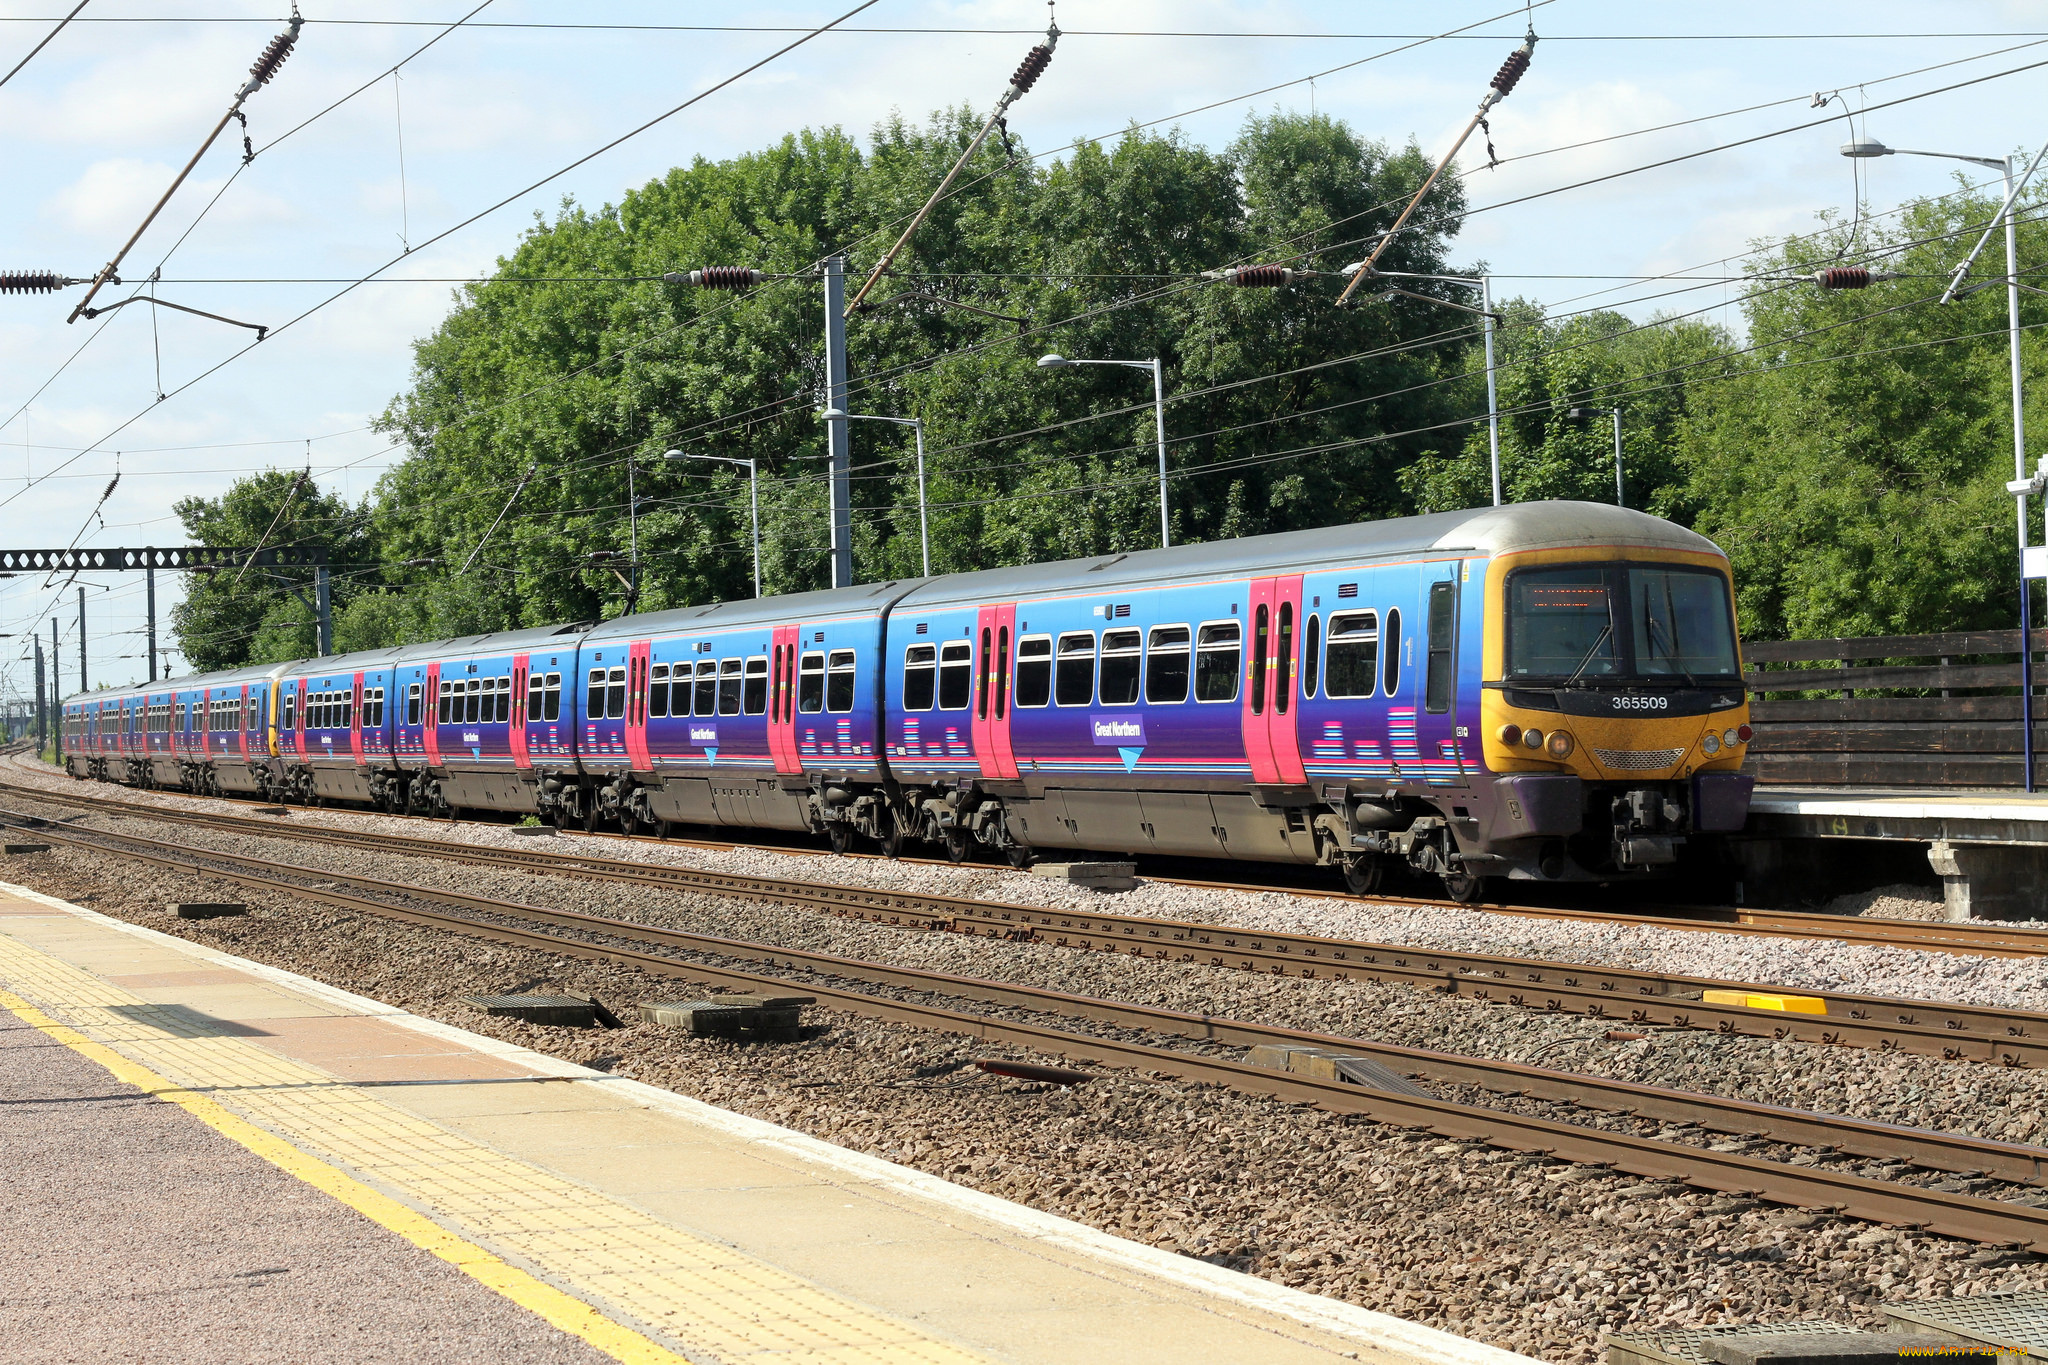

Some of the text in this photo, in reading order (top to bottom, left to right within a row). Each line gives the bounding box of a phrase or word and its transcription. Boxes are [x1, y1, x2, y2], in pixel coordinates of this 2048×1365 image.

[1612, 696, 1668, 710] 365509
[1094, 721, 1141, 737] Great Northern
